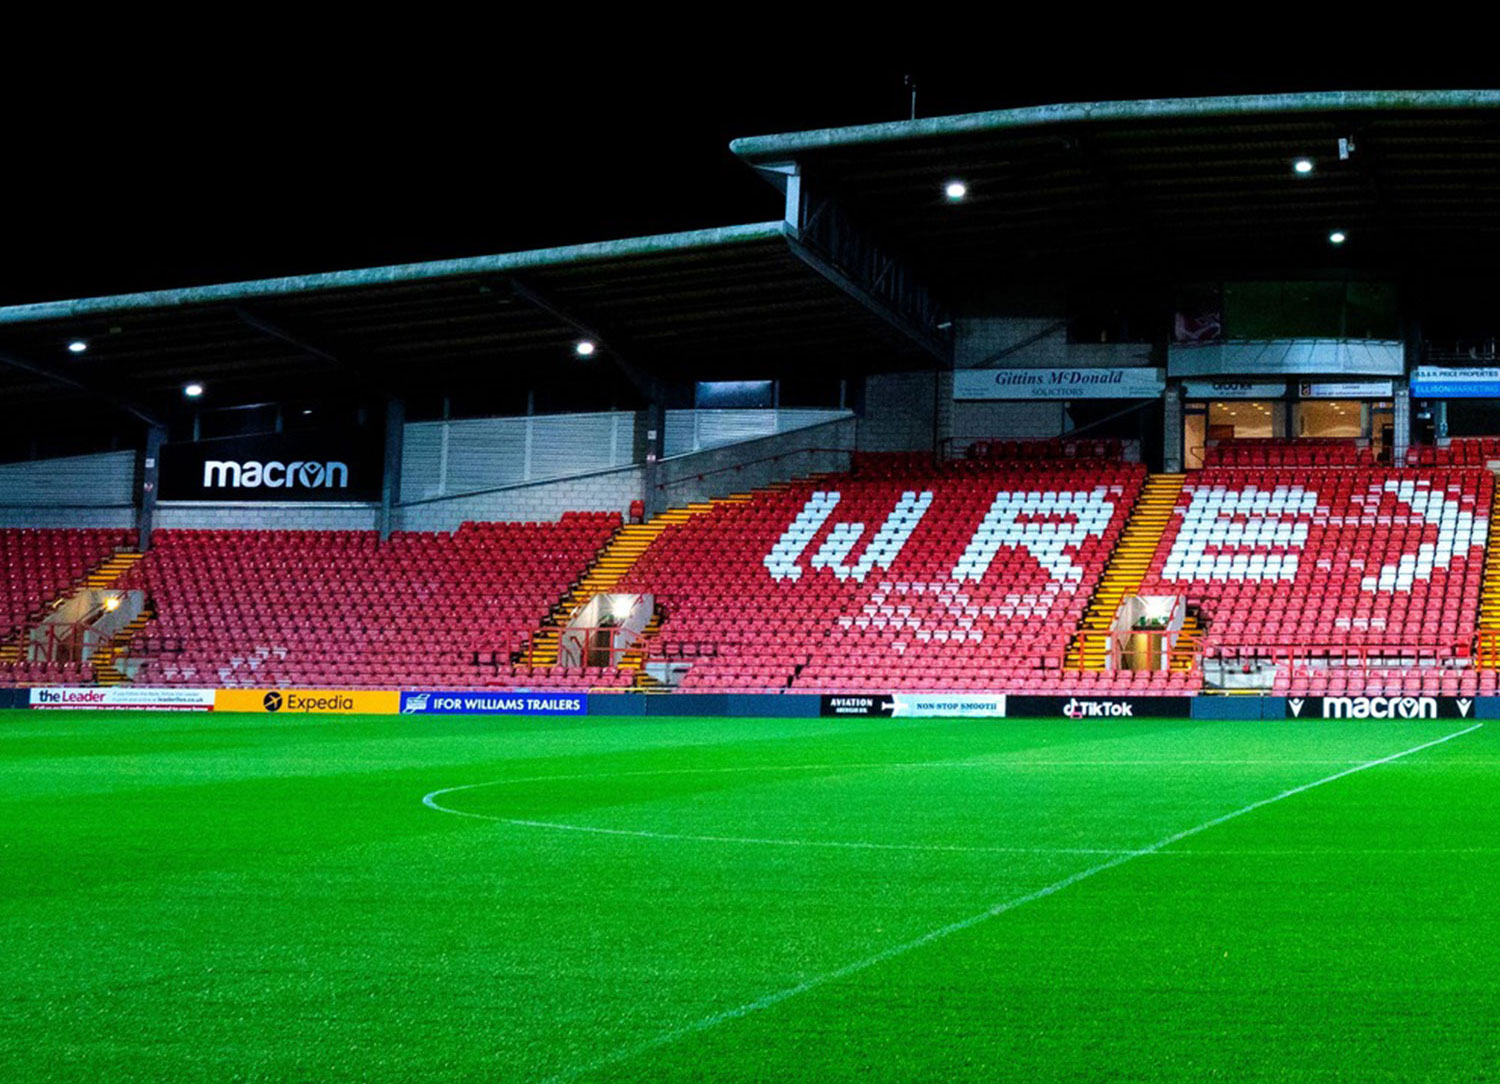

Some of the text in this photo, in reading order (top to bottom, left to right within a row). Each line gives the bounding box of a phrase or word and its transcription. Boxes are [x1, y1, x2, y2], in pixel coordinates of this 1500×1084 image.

[995, 371, 1043, 385] Gittins
[1032, 388, 1083, 396] SOLICITORS
[203, 461, 349, 488] macron
[39, 690, 60, 702] the
[62, 690, 106, 702] Leader
[830, 698, 873, 707] AVIATION
[287, 695, 353, 713] Expedia
[434, 698, 580, 711] IFOR WILLIAMS TRAILERS
[1081, 701, 1132, 716] TikTok
[1323, 697, 1437, 718] macron
